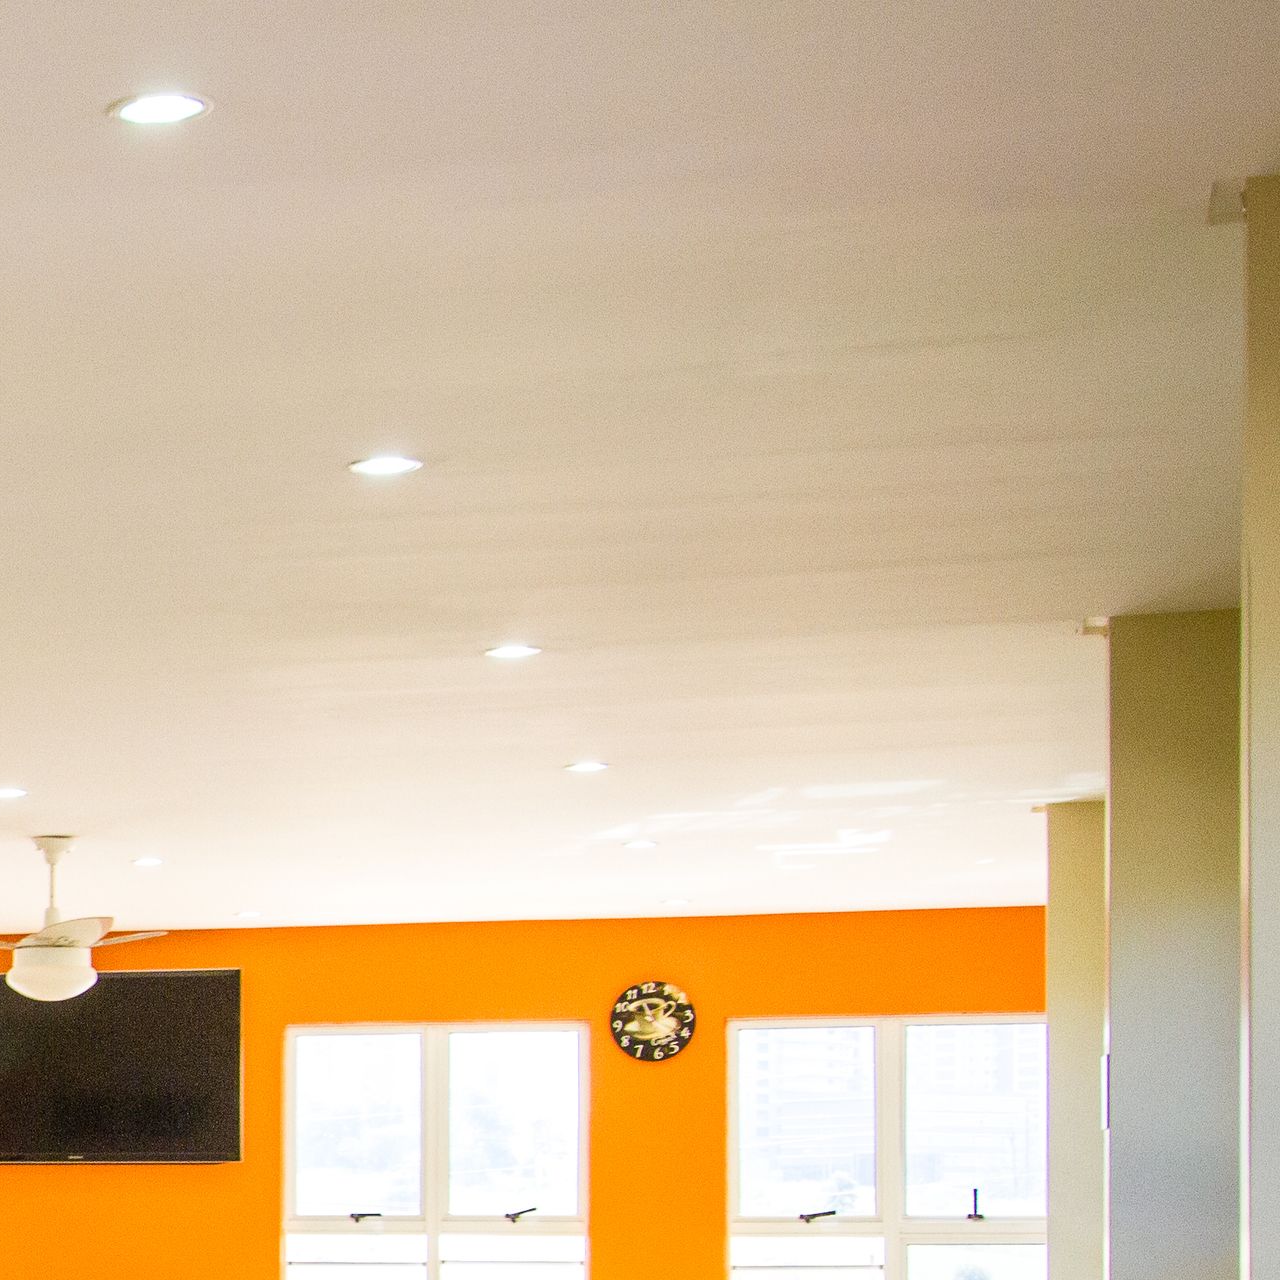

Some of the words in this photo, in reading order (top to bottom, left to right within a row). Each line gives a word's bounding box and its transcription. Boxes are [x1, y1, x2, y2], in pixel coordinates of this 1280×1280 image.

[641, 982, 657, 993] 12
[626, 989, 638, 1000] 11
[615, 1001, 630, 1013] 10
[683, 1009, 694, 1023] 3
[612, 1020, 623, 1033] 9
[680, 1027, 691, 1038] 4
[621, 1035, 630, 1047] 8
[668, 1041, 679, 1053] 5
[634, 1045, 644, 1057] 7
[653, 1047, 664, 1059] 6
